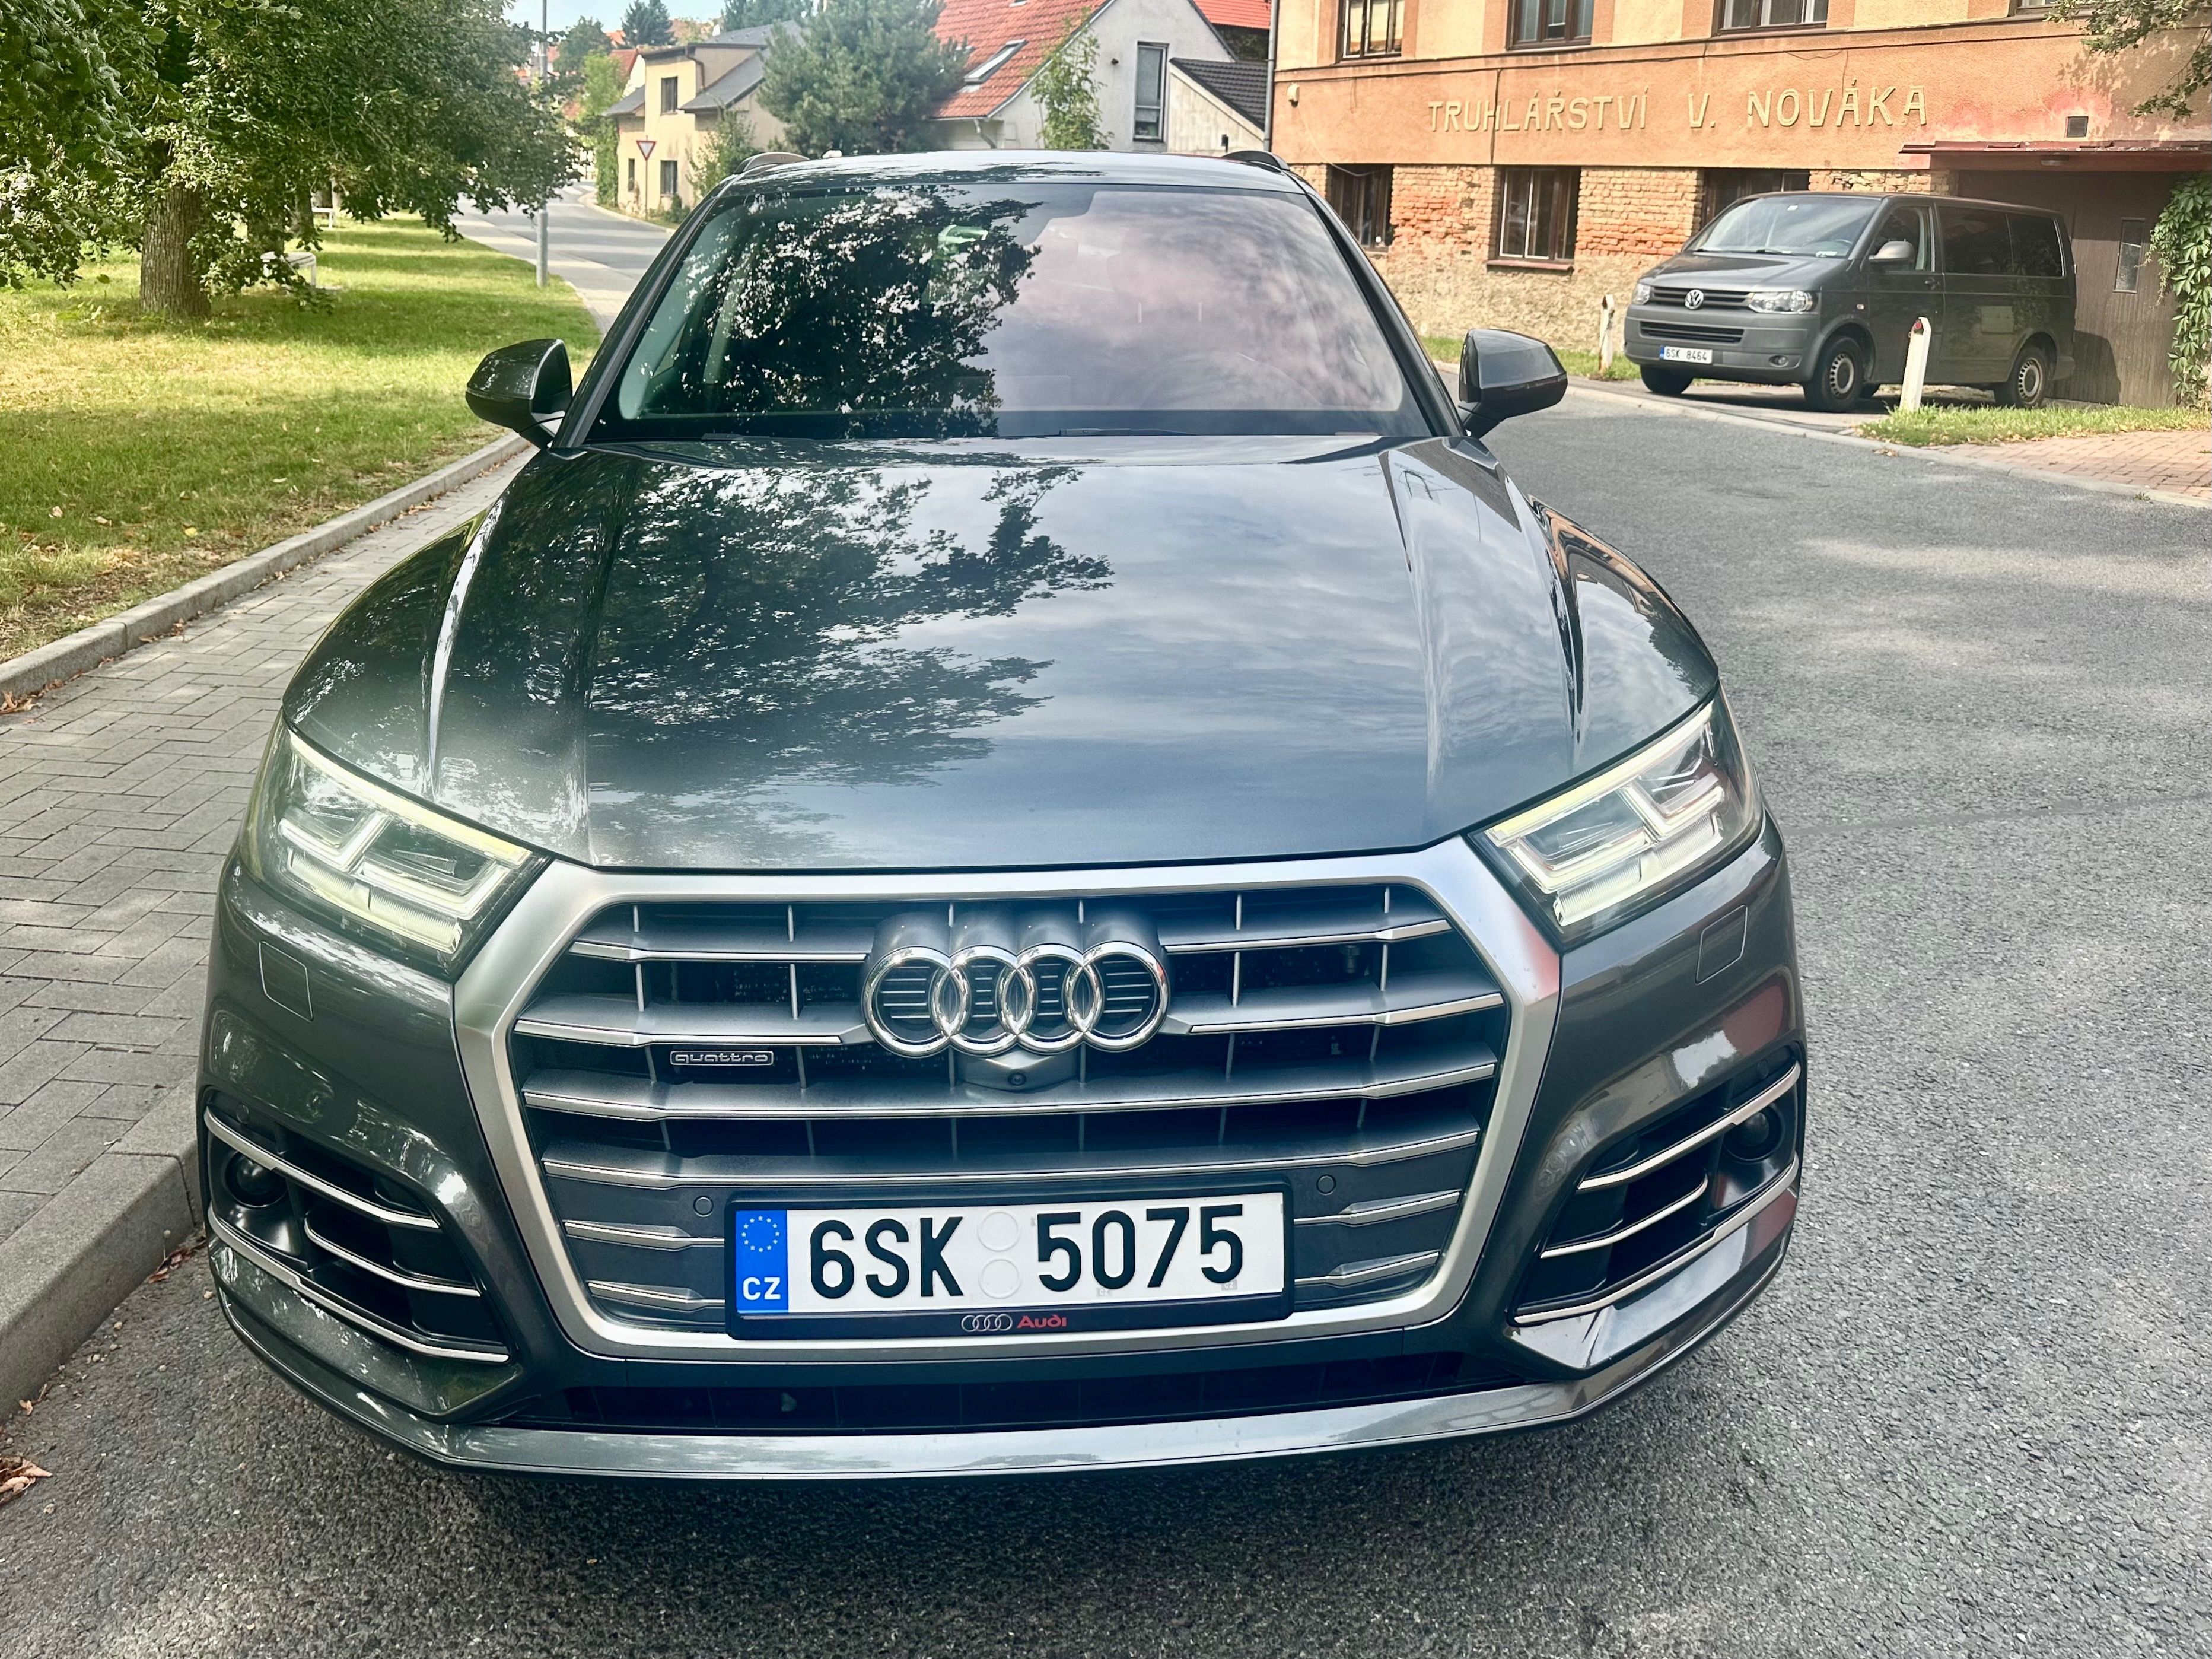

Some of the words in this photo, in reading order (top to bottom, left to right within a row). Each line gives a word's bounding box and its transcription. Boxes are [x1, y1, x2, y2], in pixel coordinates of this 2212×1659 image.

[1428, 87, 1649, 132] TRUHLÁŘSTVÍ
[1688, 93, 1716, 131] V.
[1747, 77, 1928, 128] NOVÁKA
[1686, 350, 1707, 361] 8464
[675, 1053, 768, 1064] quattro
[809, 1216, 963, 1299] 6SK
[1036, 1204, 1243, 1292] 5075
[743, 1276, 781, 1301] CZ
[1017, 1314, 1067, 1329] Audi
